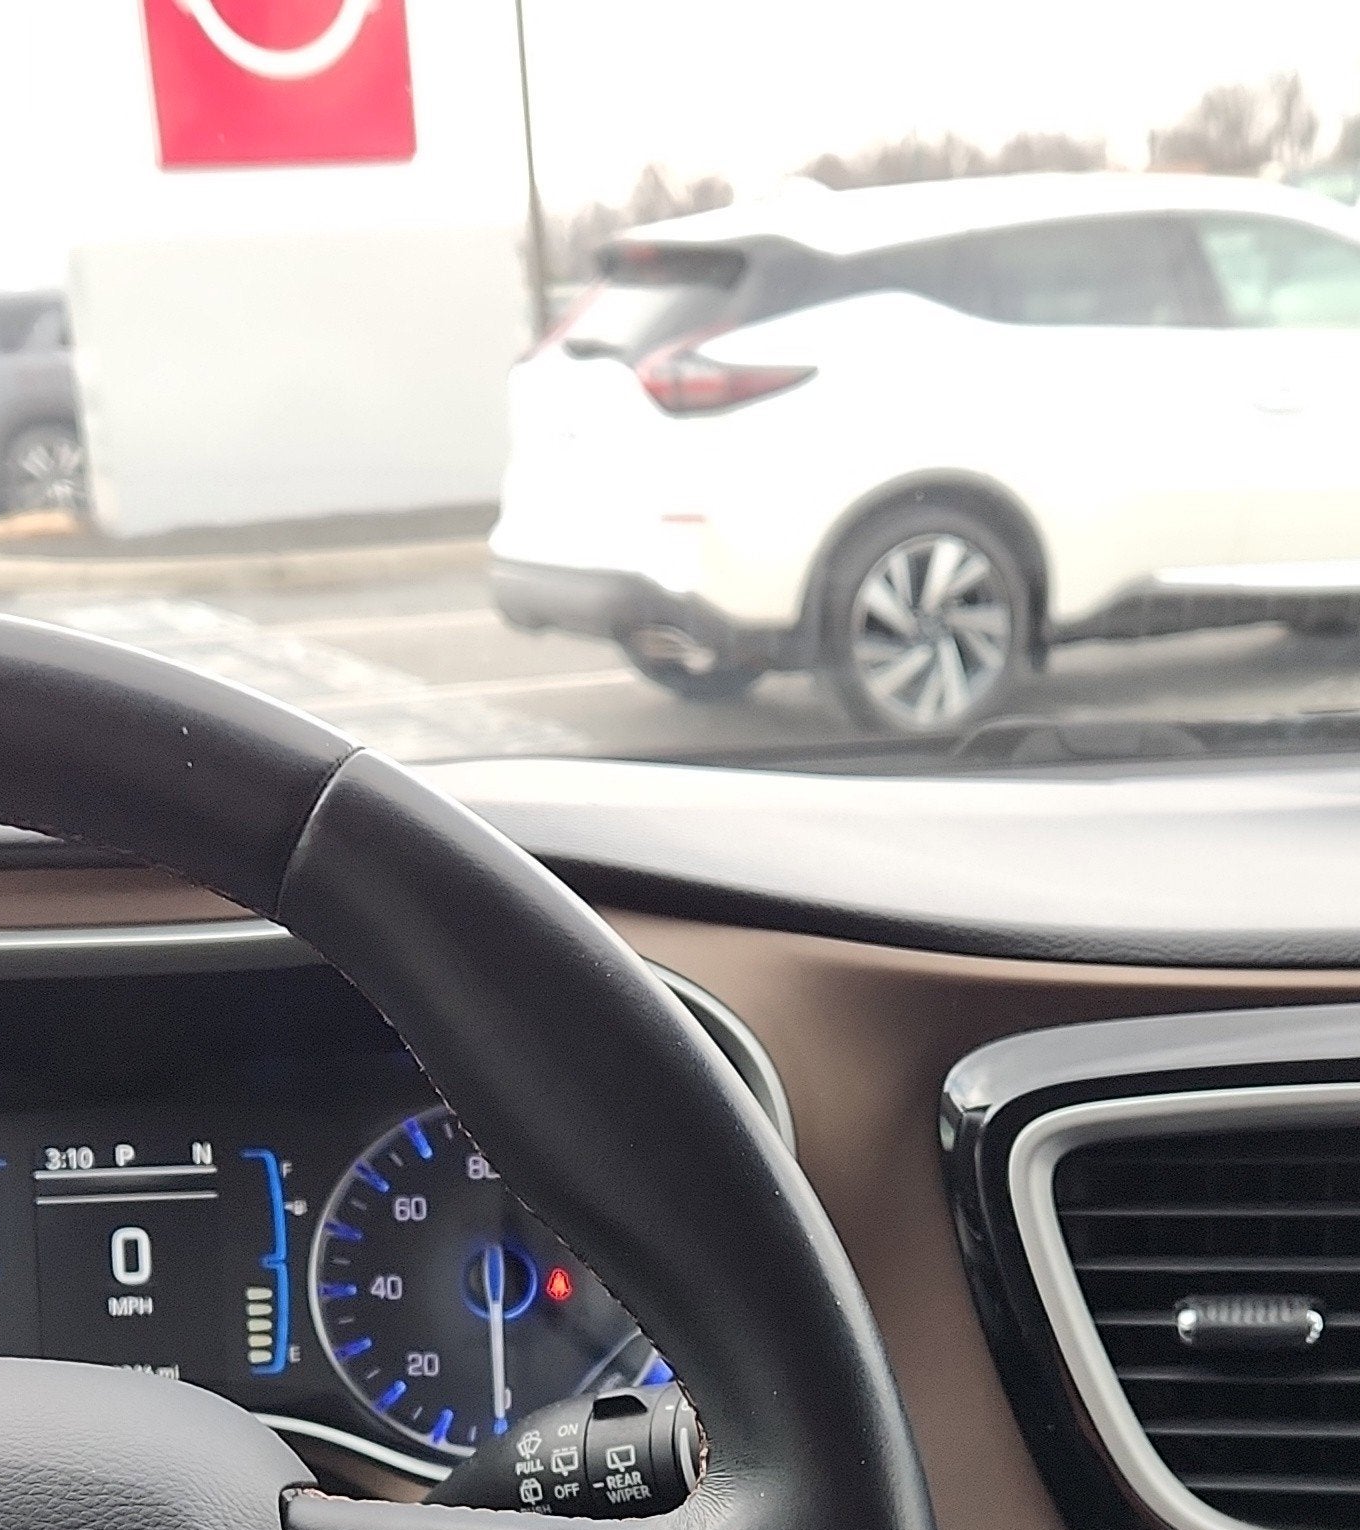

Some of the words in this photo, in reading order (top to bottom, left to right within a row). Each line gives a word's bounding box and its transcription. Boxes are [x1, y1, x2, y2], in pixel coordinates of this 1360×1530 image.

[45, 1146, 94, 1171] 3:10
[115, 1143, 136, 1167] P
[192, 1142, 213, 1166] N
[282, 1162, 293, 1179] F
[394, 1198, 428, 1221] 60
[111, 1226, 152, 1286] 0
[371, 1276, 403, 1300] 40
[108, 1296, 153, 1316] MPH
[408, 1353, 439, 1378] 20
[557, 1422, 579, 1438] ON
[515, 1458, 544, 1475] PULL
[554, 1482, 580, 1500] OFF
[606, 1471, 642, 1490] REAR
[606, 1484, 651, 1504] WIPER
